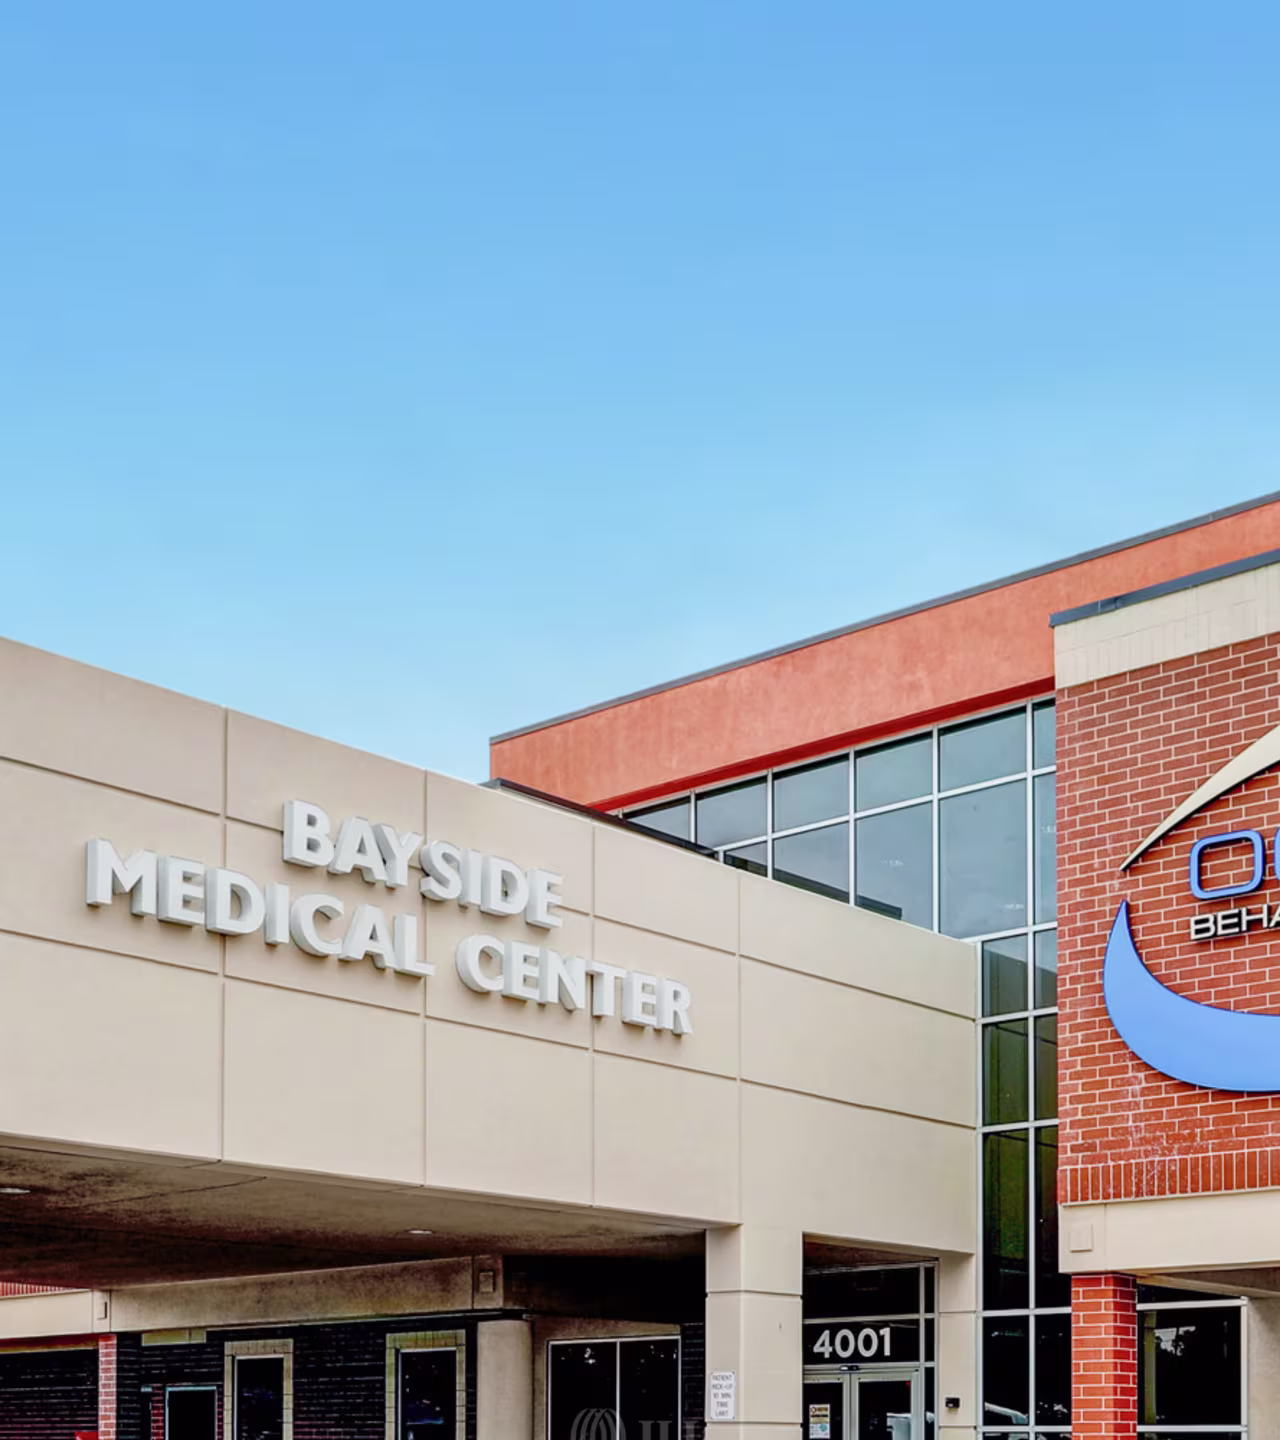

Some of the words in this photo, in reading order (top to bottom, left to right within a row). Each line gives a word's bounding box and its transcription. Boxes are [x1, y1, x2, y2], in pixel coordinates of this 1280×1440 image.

[282, 799, 564, 930] BAYSIDE
[86, 837, 435, 977] MEDICAL
[455, 933, 693, 1036] CENTER
[813, 1327, 891, 1359] 4001
